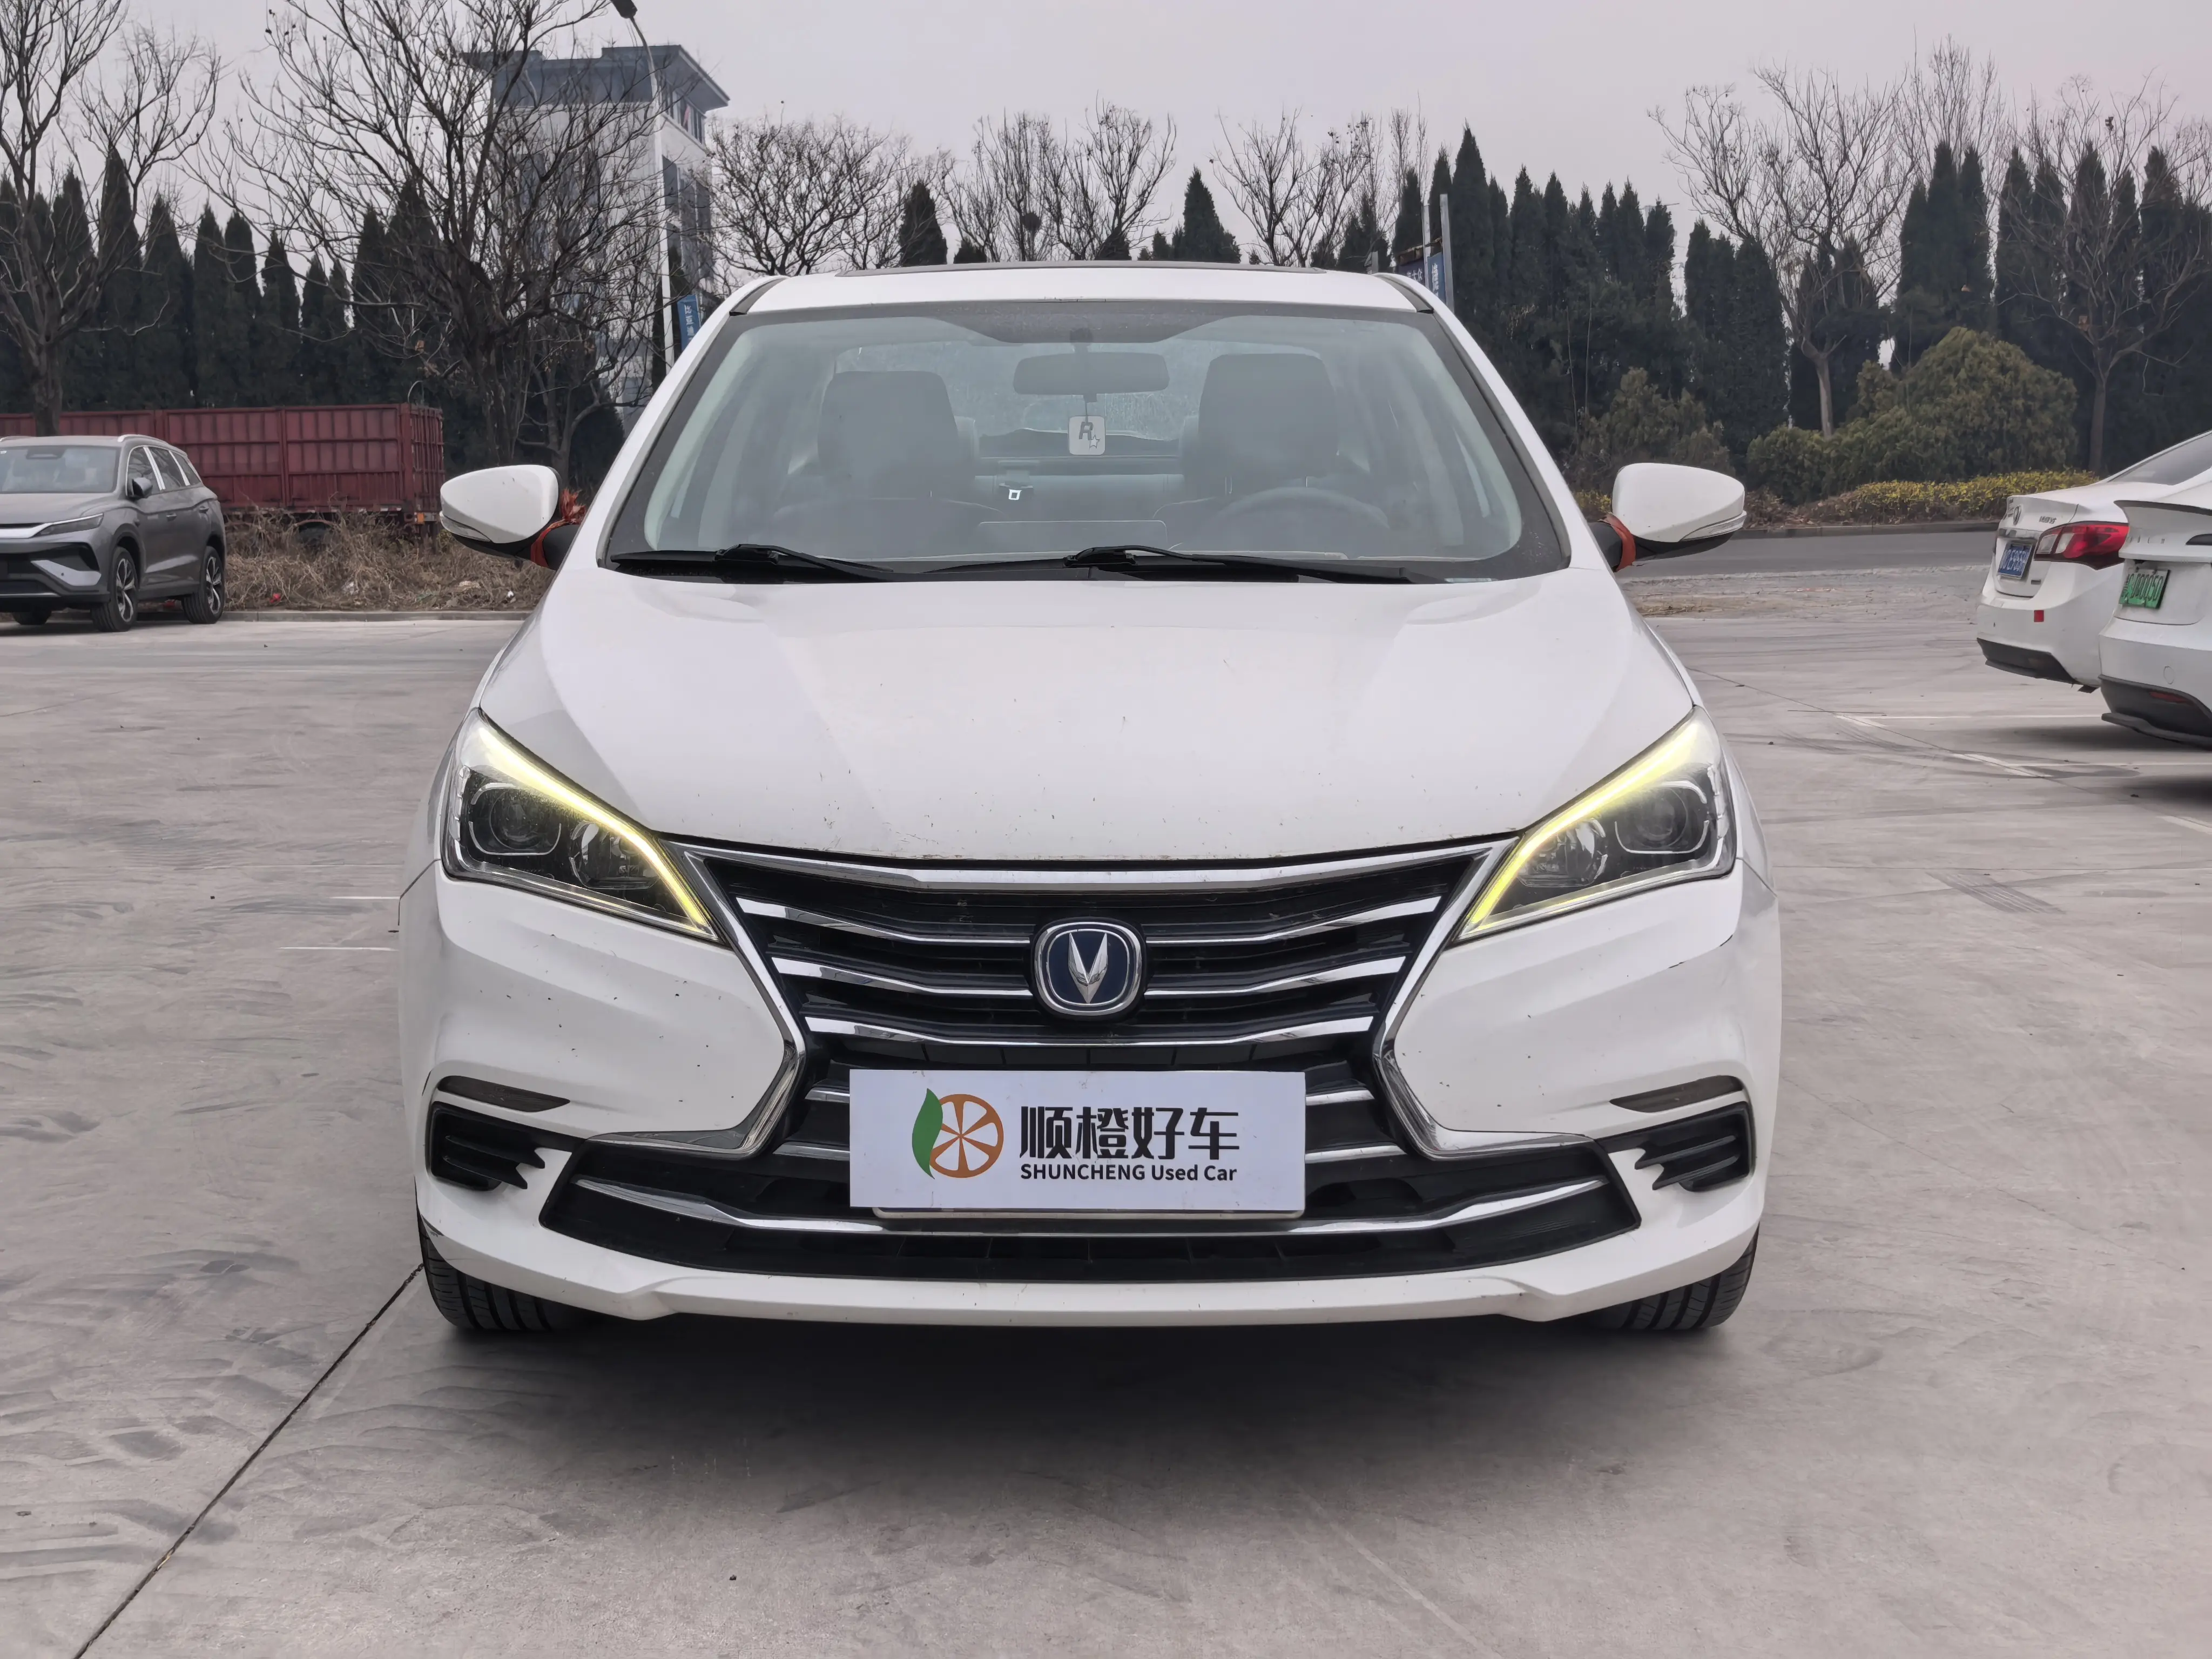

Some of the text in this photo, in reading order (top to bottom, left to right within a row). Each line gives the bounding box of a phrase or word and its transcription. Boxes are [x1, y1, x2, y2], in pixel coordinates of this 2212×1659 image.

[1020, 1106, 1240, 1160] 顺橙好车
[1021, 1163, 1237, 1181] SHUNCHENG Used Car
